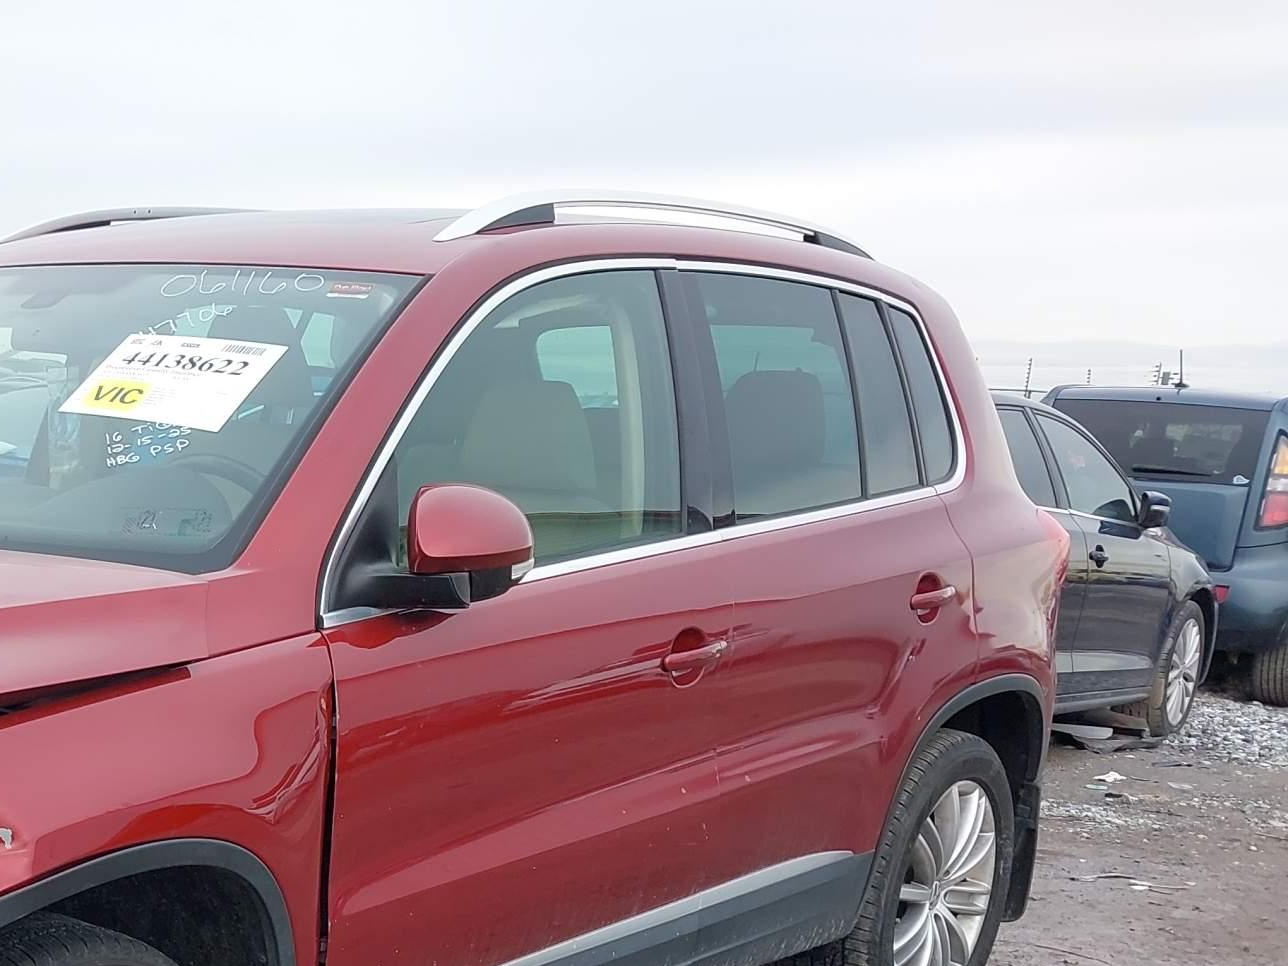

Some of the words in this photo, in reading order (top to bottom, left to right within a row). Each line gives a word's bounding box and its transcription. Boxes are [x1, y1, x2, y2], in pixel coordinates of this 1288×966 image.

[160, 269, 325, 297] 061160
[121, 351, 250, 376] 44138622
[93, 385, 145, 405] VIC
[105, 431, 123, 445] 16
